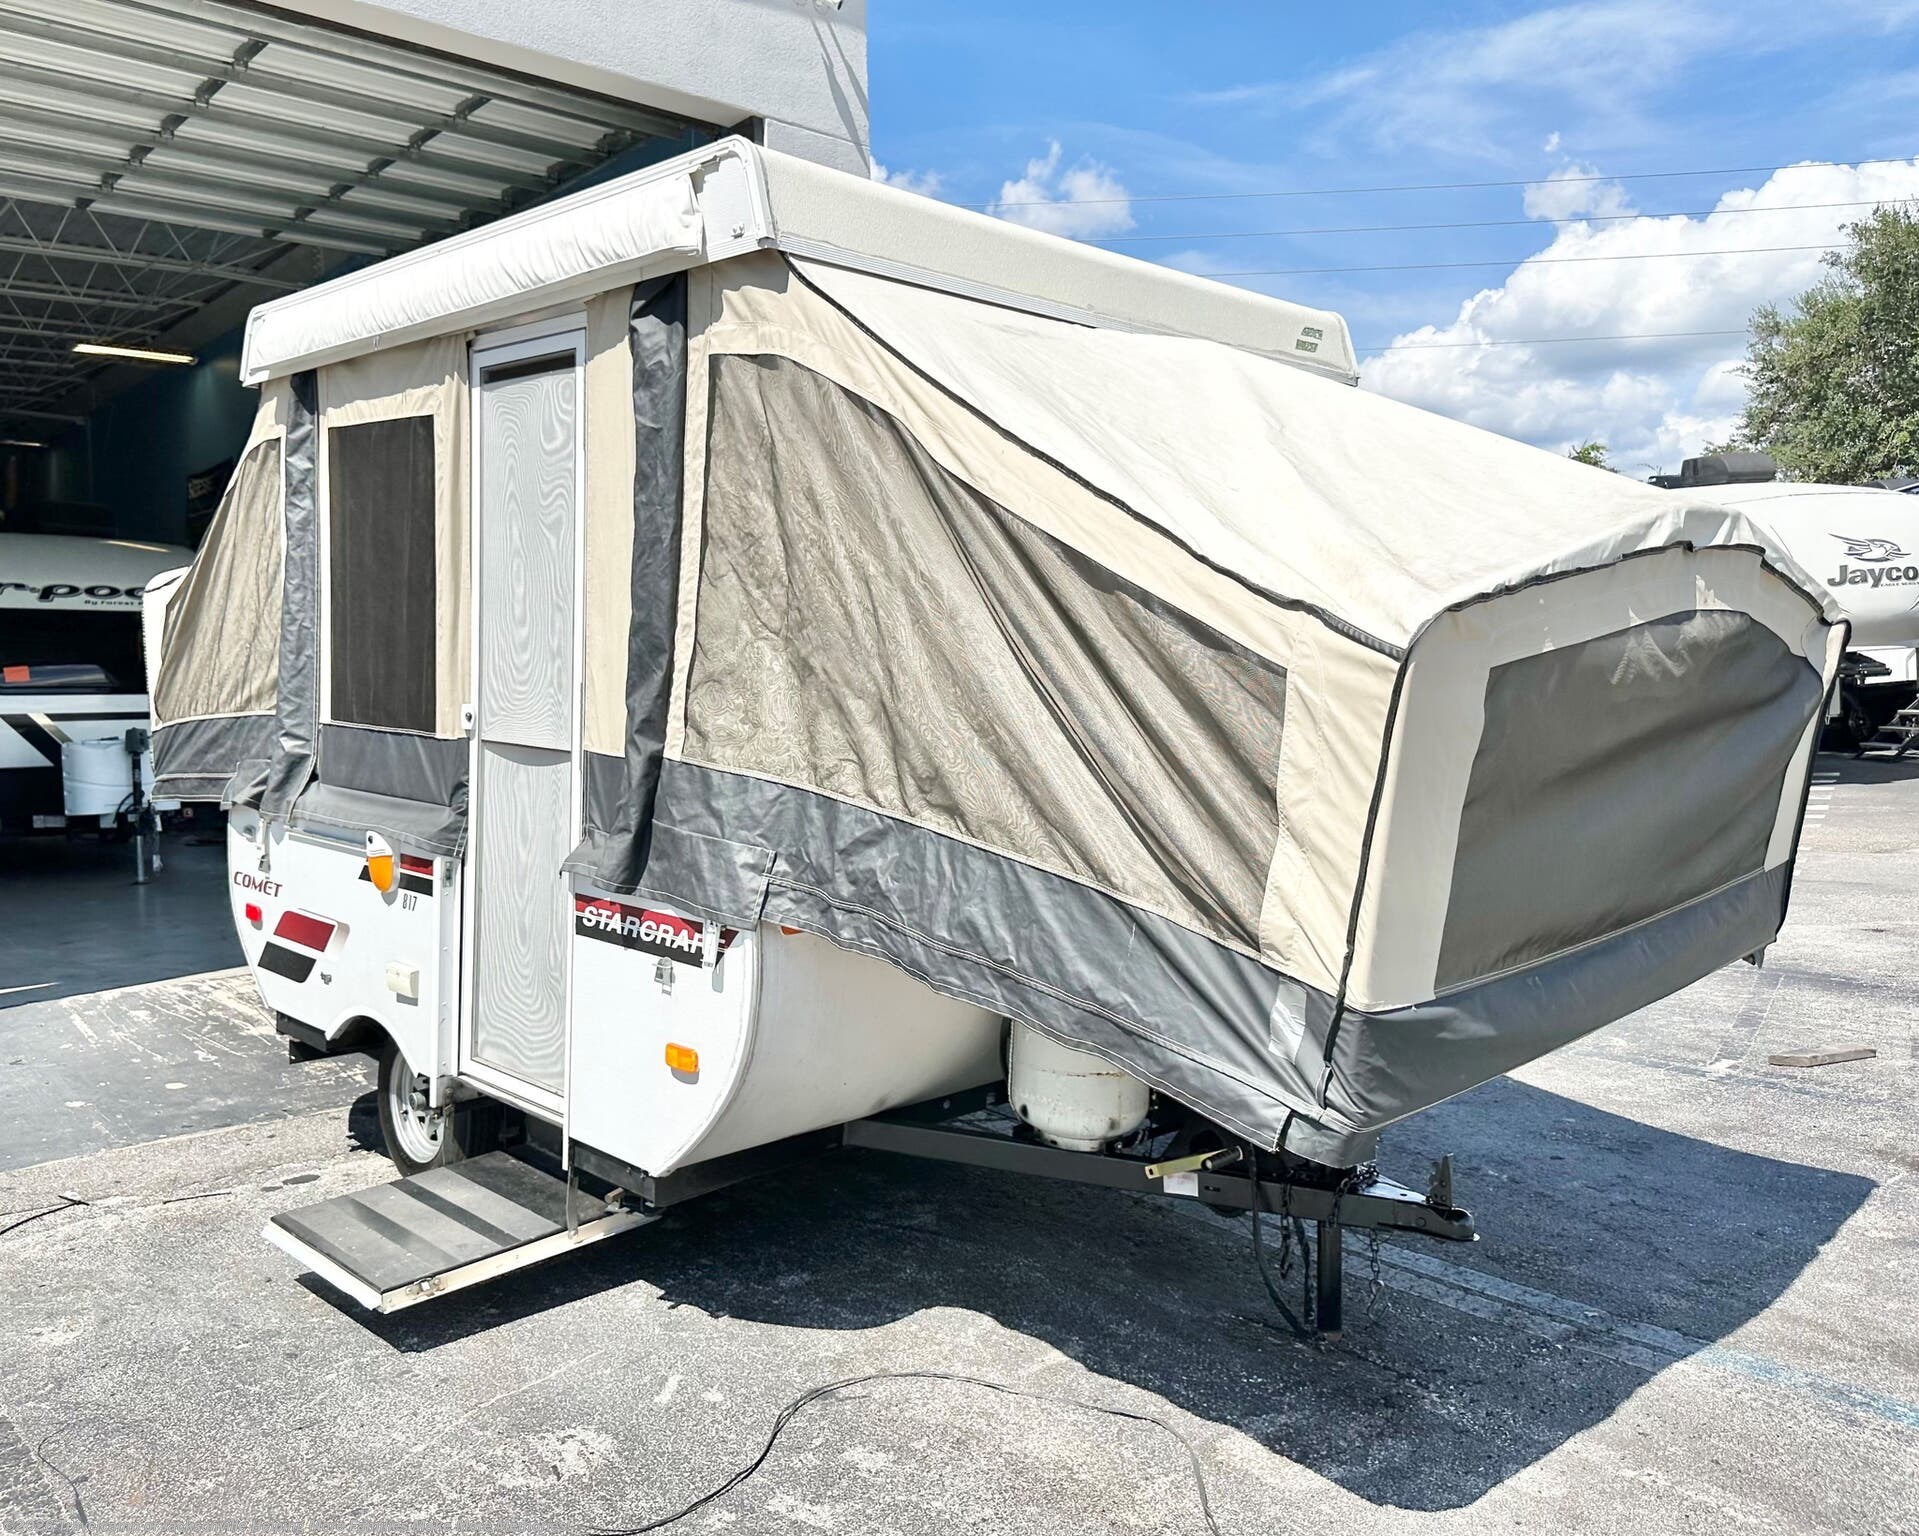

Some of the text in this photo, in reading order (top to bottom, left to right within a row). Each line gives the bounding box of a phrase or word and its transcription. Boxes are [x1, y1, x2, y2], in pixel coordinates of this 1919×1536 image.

[1827, 565, 1919, 588] Jayco
[233, 871, 283, 897] COMET
[402, 893, 418, 911] 817
[582, 905, 726, 955] STARCRAF
